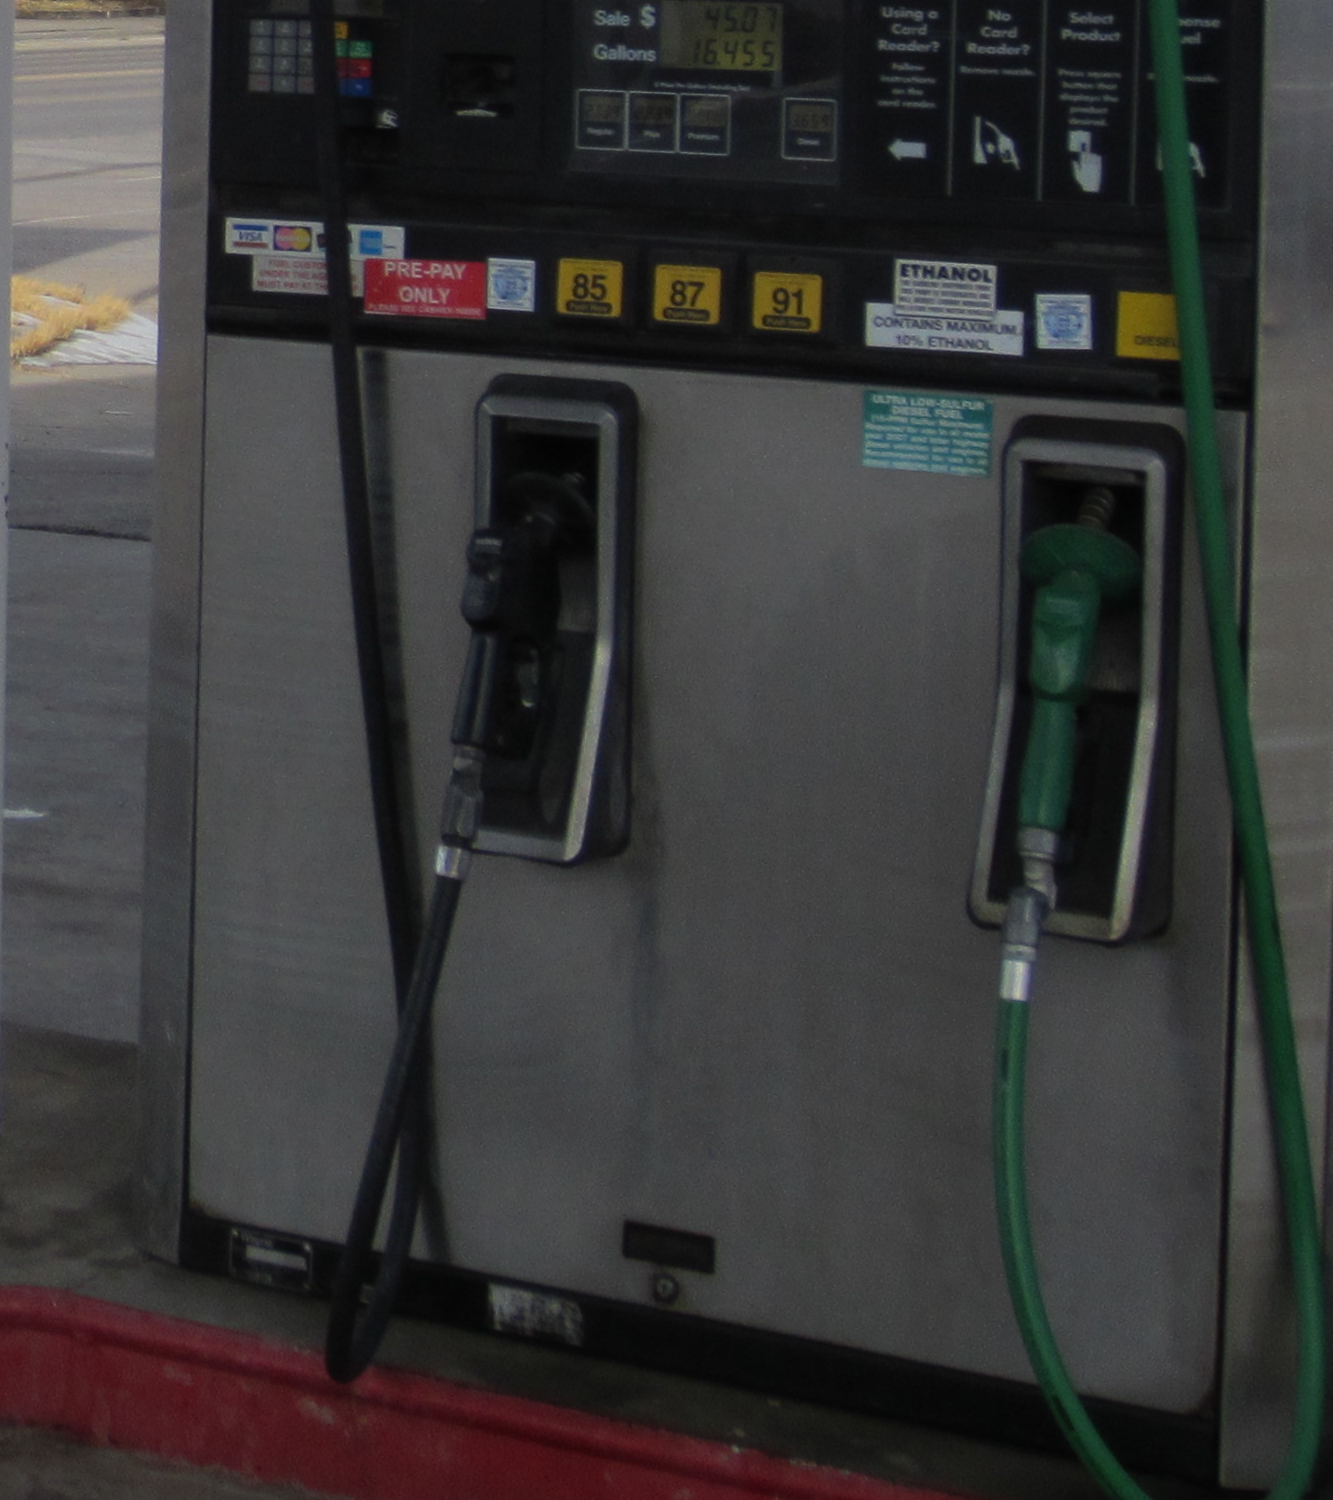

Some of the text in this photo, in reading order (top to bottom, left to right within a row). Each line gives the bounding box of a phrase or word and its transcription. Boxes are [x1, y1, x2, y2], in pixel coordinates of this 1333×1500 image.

[594, 4, 656, 30] Sale $
[880, 6, 924, 22] Using
[988, 9, 1013, 21] No
[1068, 12, 1114, 25] Select
[891, 23, 928, 36] Card
[979, 26, 1019, 40] Card
[1061, 28, 1121, 42] Product
[593, 43, 657, 63] Gallons
[878, 39, 940, 54] Reader?
[967, 42, 1031, 56] Reader?
[238, 231, 263, 242] VISA
[384, 261, 467, 280] PRE-PAY
[899, 263, 993, 283] ETHANOL
[572, 272, 608, 301] 85
[670, 280, 705, 307] 87
[399, 286, 450, 304] ONLY
[772, 287, 803, 315] 91
[873, 315, 943, 331] CONTAINS
[895, 334, 994, 351] 10% ETHANOL
[933, 408, 964, 421] FUEL
